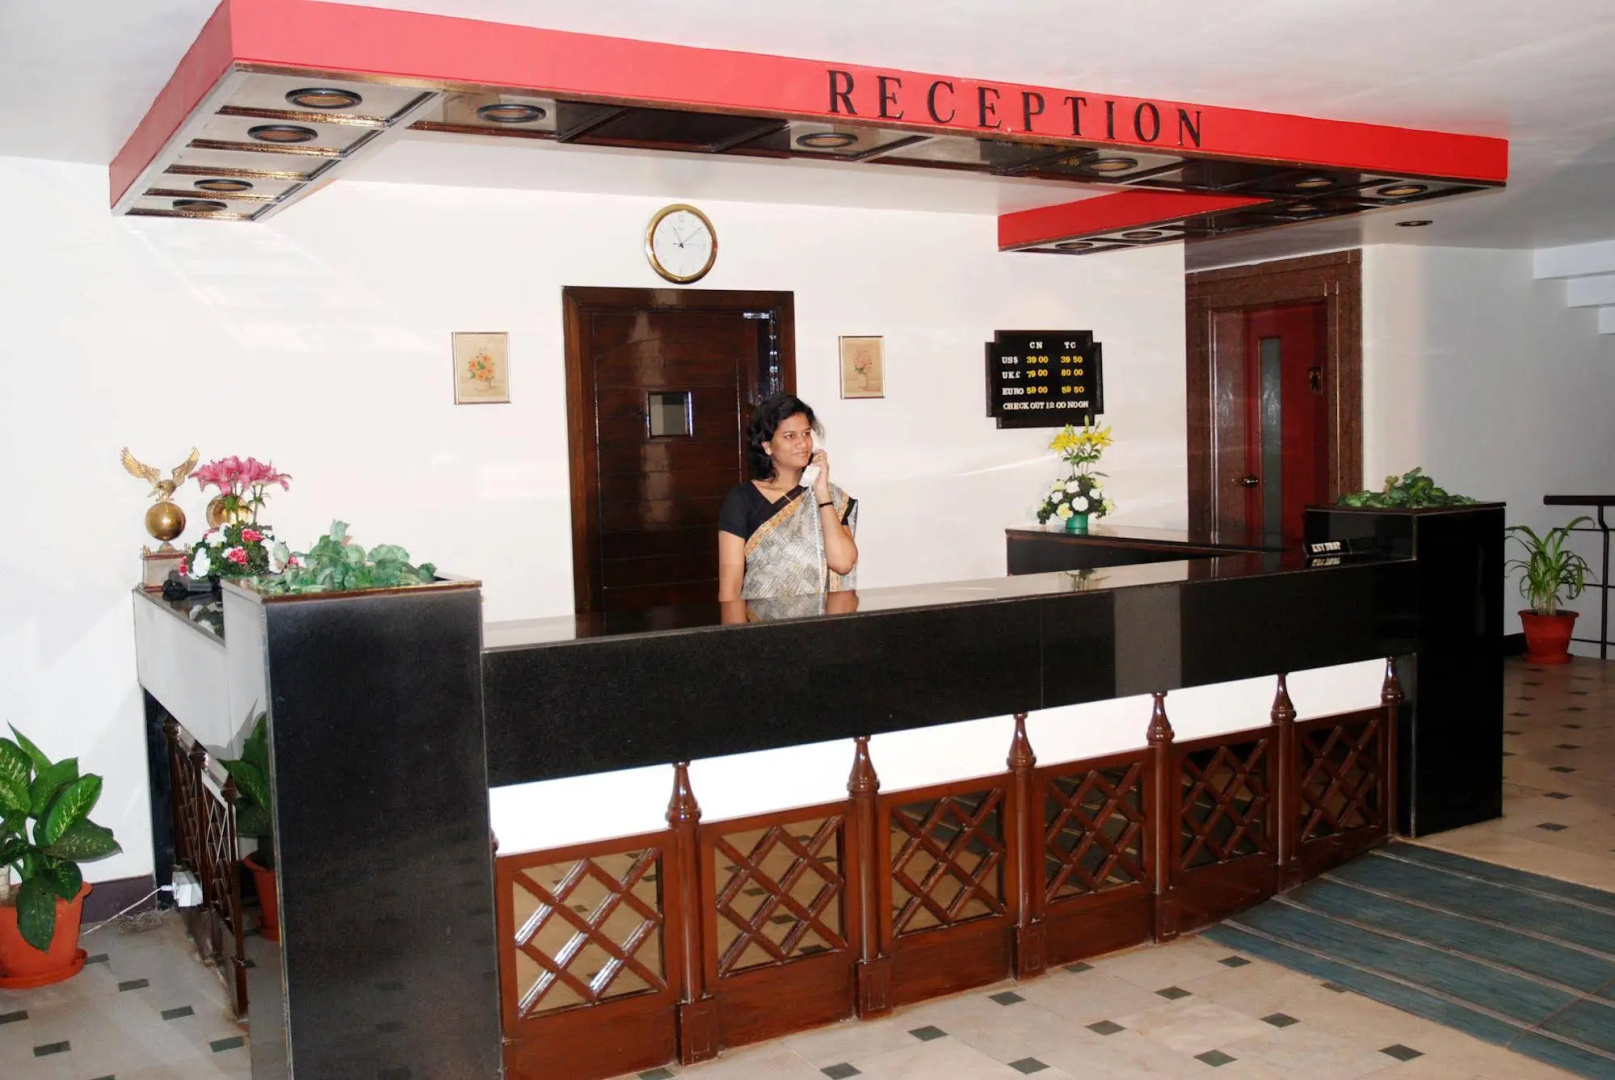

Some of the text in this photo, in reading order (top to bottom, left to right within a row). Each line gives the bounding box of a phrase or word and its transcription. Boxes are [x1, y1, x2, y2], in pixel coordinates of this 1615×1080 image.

[827, 69, 1202, 149] RECEPTION
[1029, 341, 1076, 349] CN TC
[1001, 356, 1019, 364] US$
[1026, 355, 1037, 363] 39
[1038, 355, 1049, 363] 00
[1060, 355, 1071, 363] 39
[1001, 371, 1021, 379] UK£
[1037, 369, 1048, 377] 00
[1002, 387, 1025, 395] EURO
[1003, 402, 1030, 410] CHECK
[1045, 401, 1055, 409] 12
[1067, 401, 1089, 409] NOON
